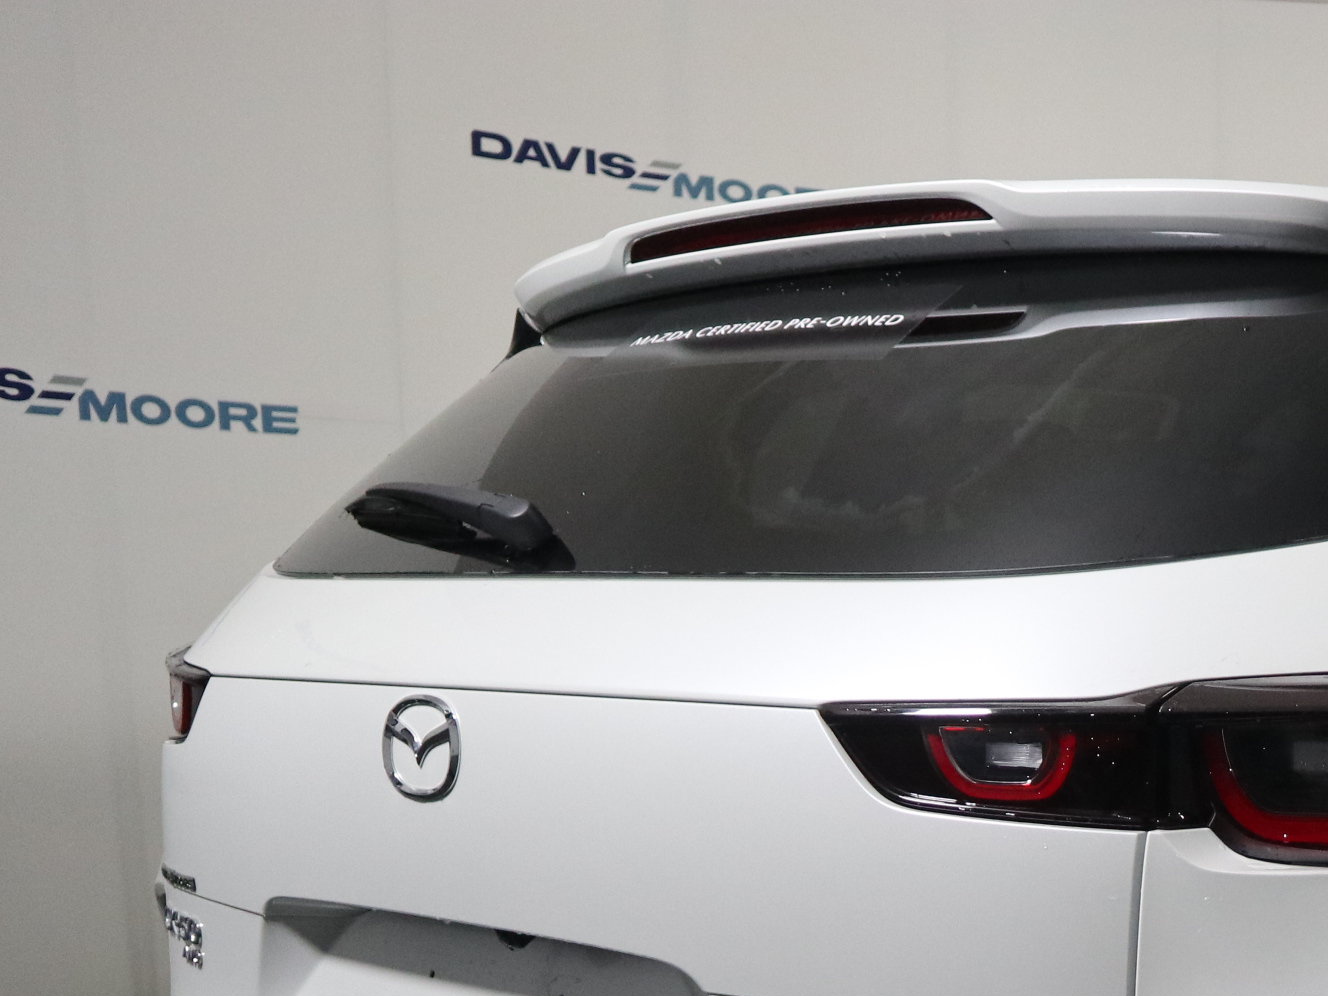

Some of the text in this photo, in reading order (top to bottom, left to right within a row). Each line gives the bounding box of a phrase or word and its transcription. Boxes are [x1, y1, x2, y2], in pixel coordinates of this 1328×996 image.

[471, 130, 825, 204] DAVIS MOO
[629, 314, 905, 348] MAZDA CERTIFIED PRE-OWNED
[78, 388, 300, 435] MOORE
